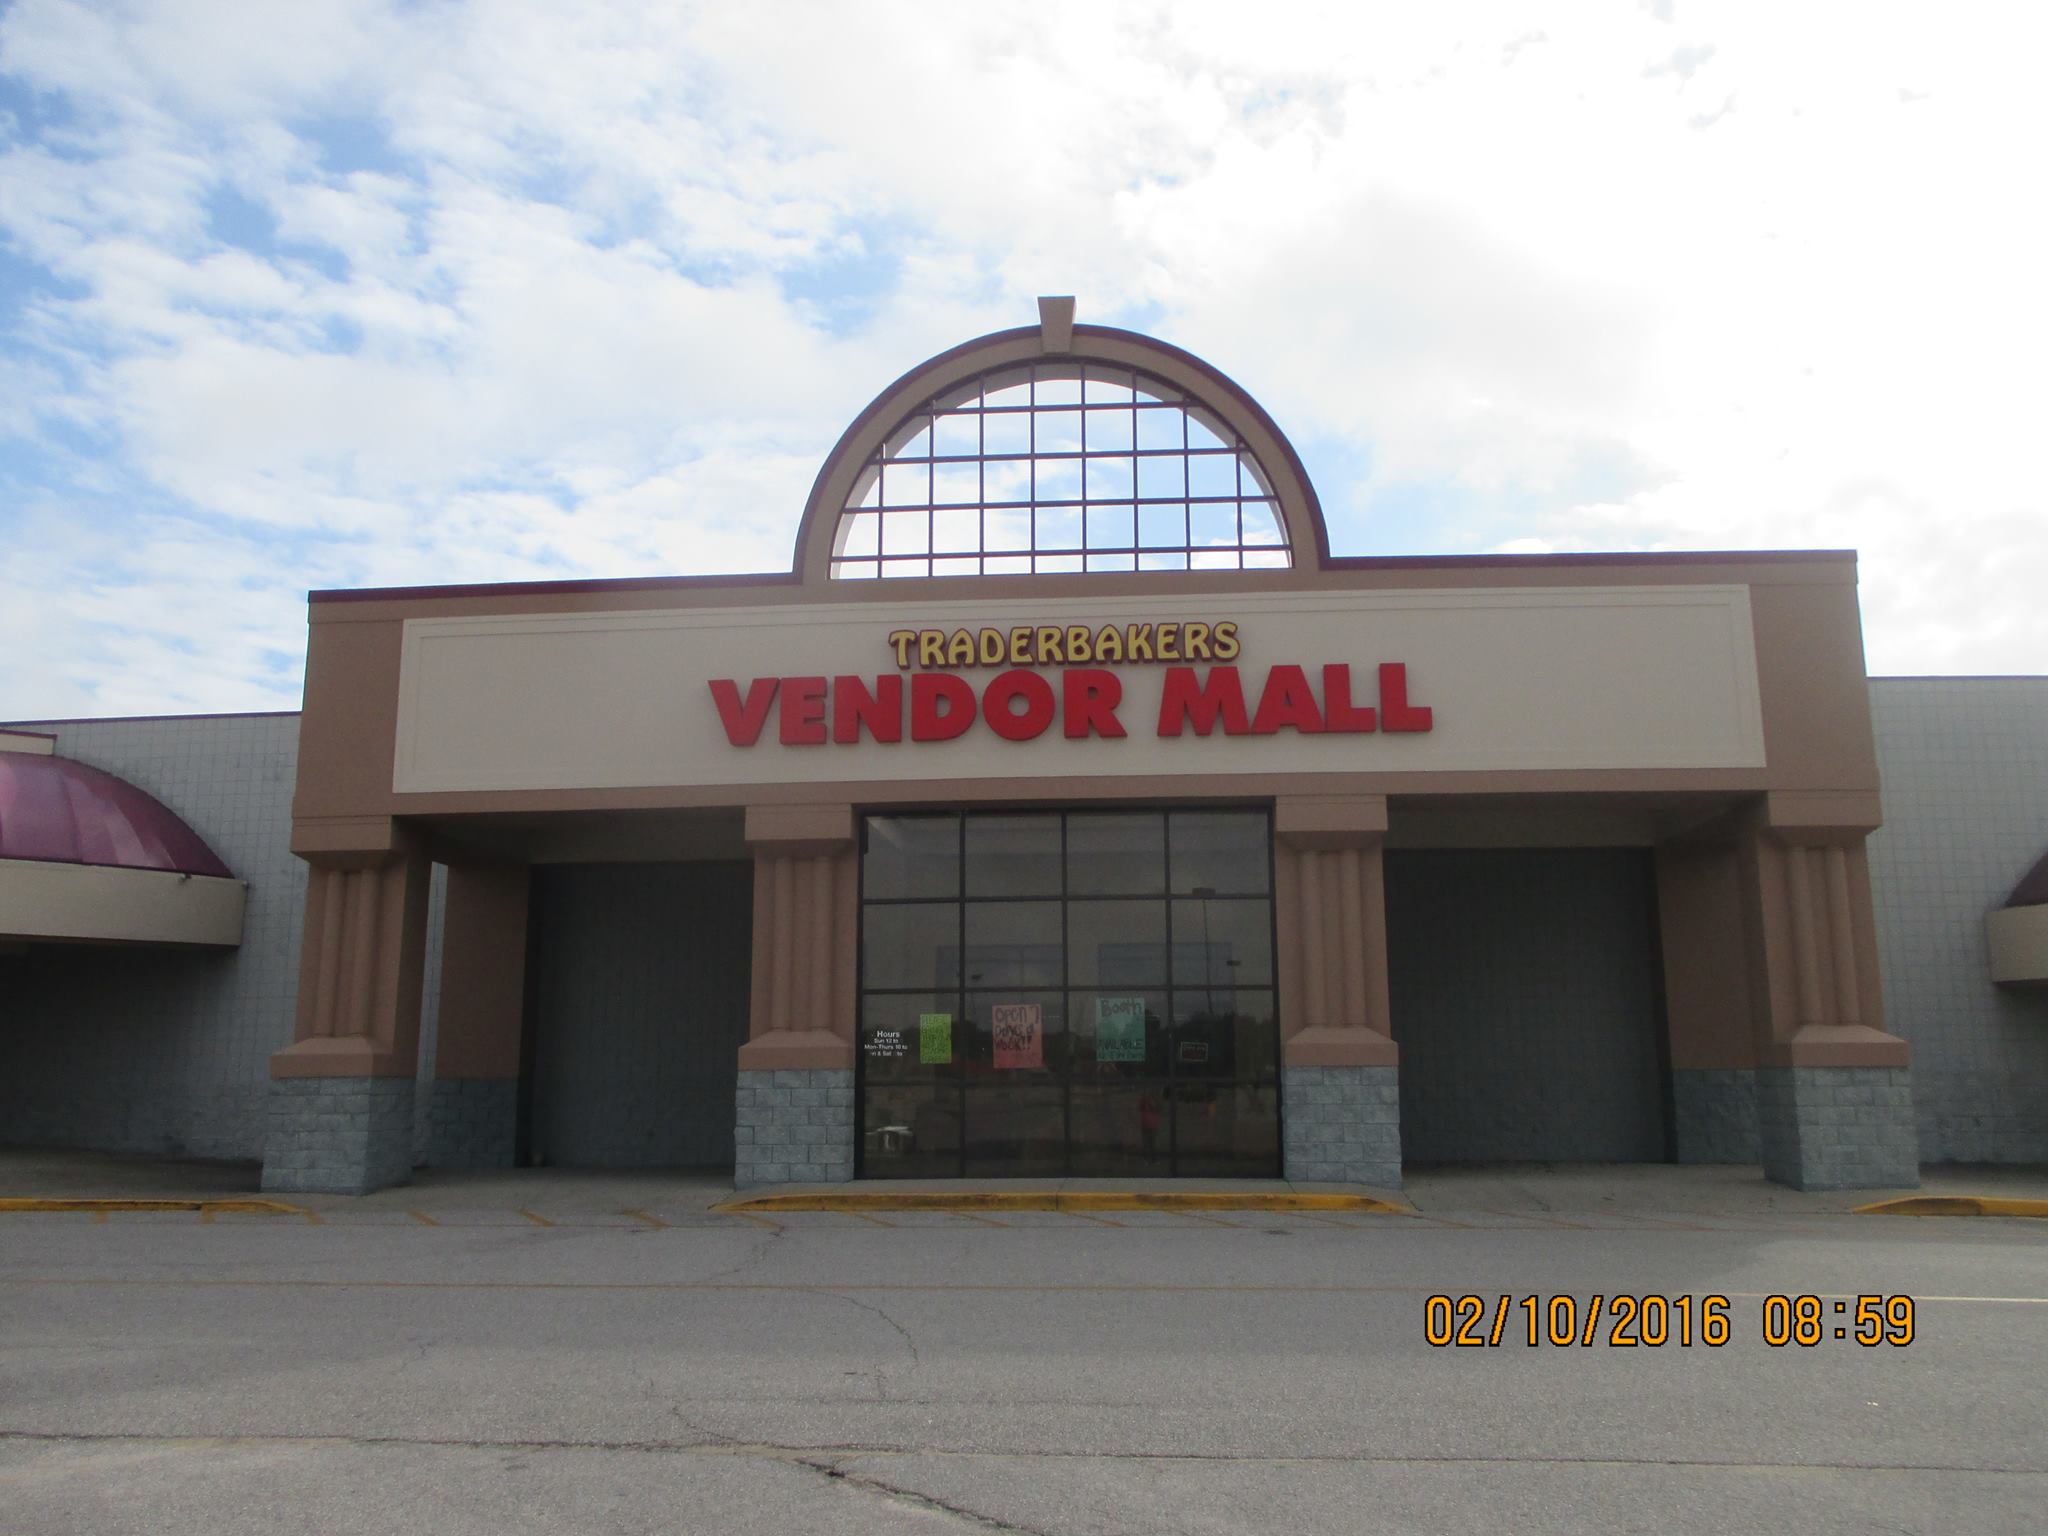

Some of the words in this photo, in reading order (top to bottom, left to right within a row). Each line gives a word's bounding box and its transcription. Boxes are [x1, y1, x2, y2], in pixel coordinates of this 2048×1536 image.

[888, 622, 1241, 669] TRADERBAKERS
[708, 668, 1128, 747] VENDOR
[1157, 662, 1433, 738] MALL
[876, 1030, 900, 1038] Hours
